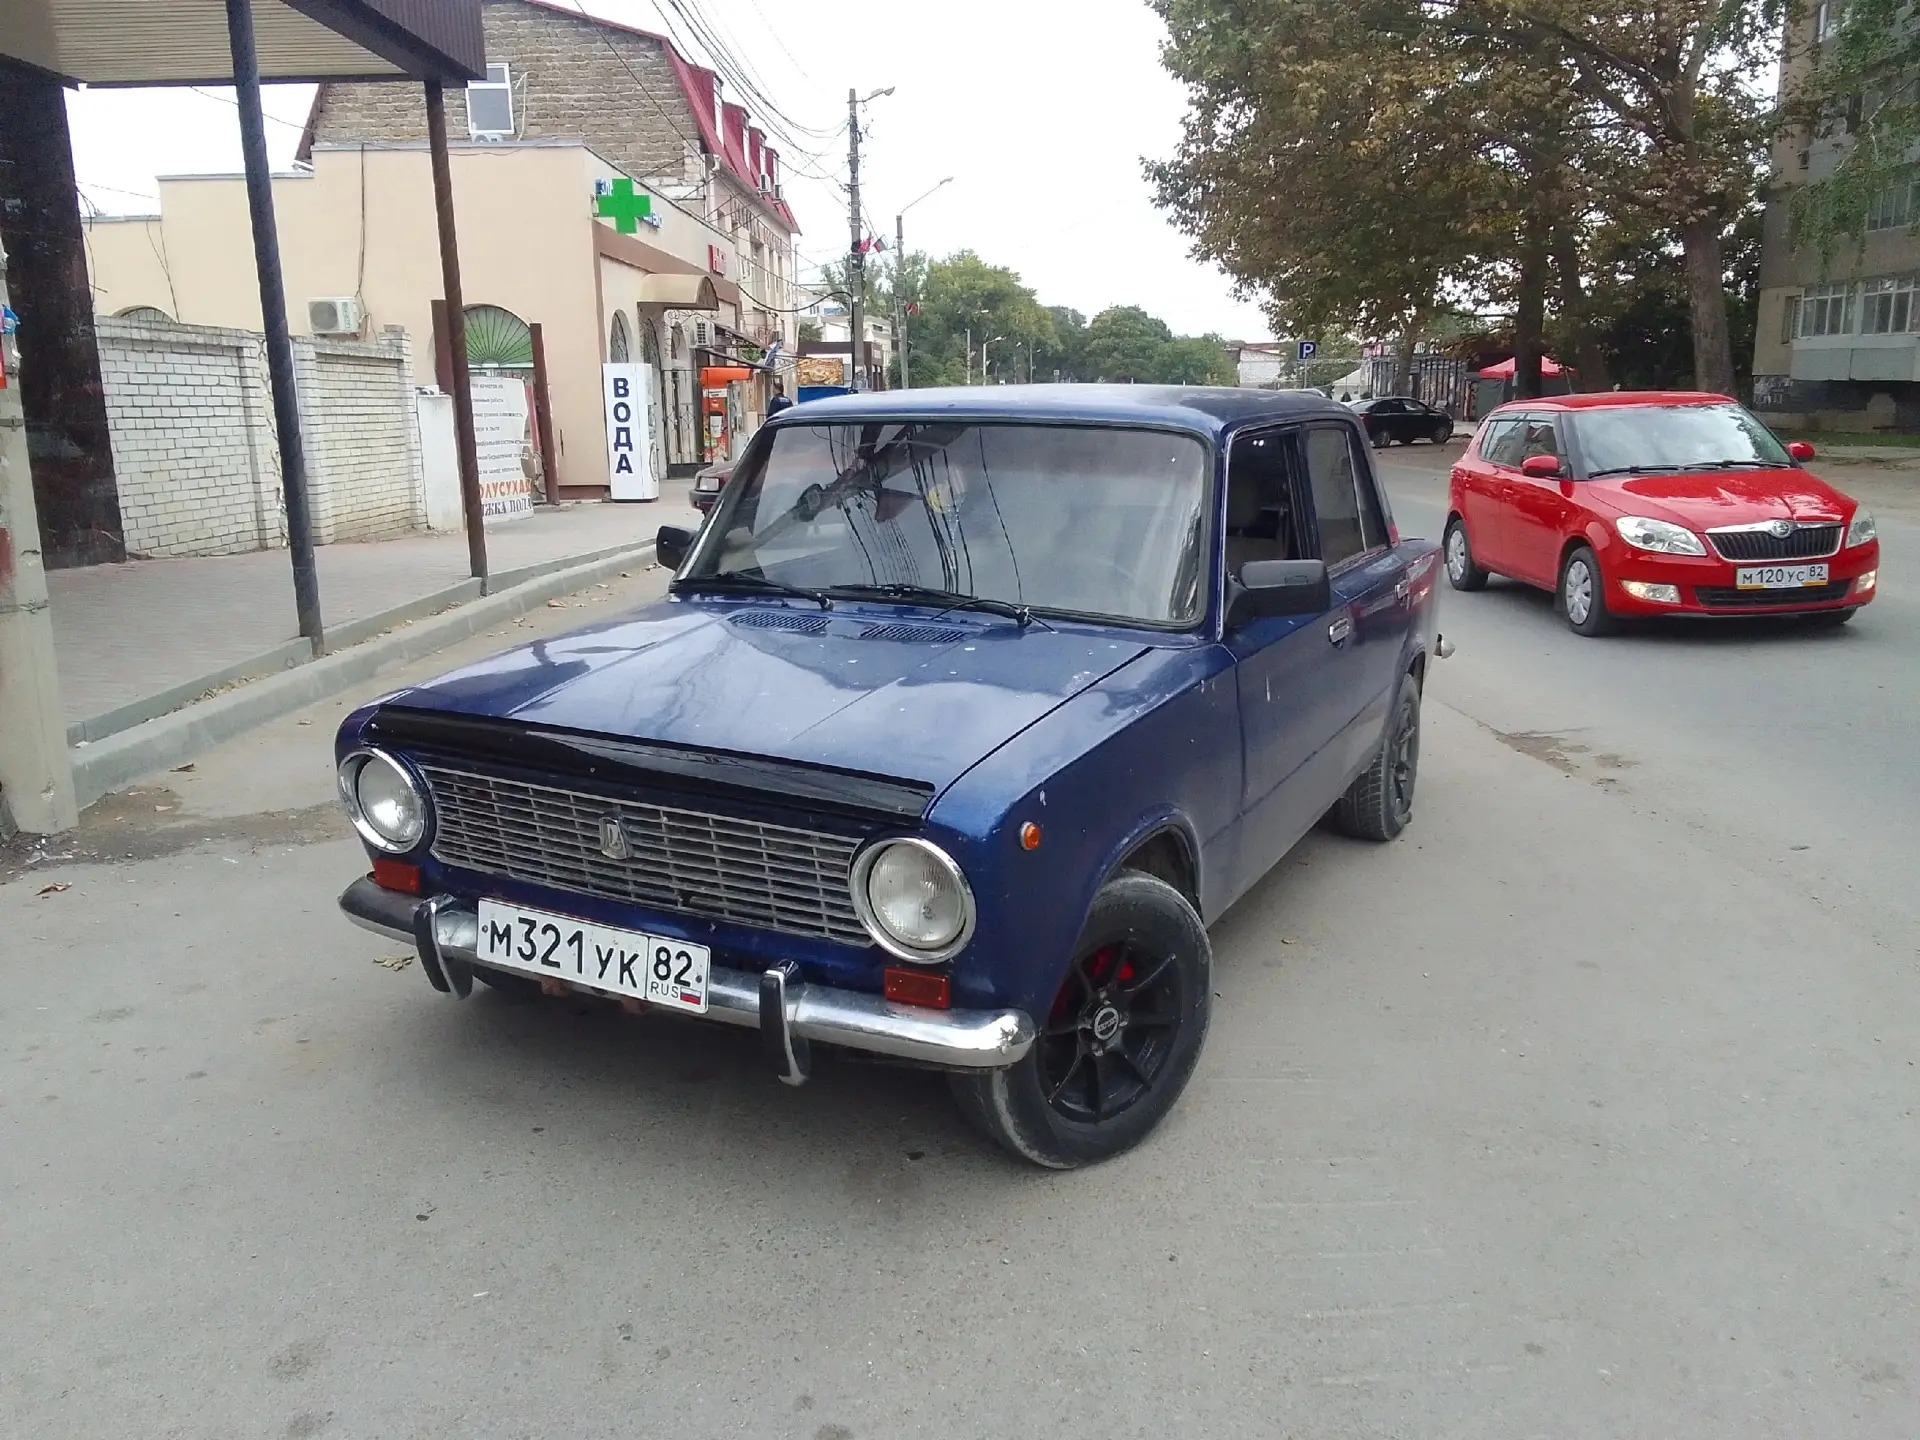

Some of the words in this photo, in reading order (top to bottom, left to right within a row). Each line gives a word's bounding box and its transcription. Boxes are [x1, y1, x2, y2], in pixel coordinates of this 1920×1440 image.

[1303, 342, 1314, 359] P
[613, 377, 634, 474] ВОДА
[1809, 565, 1825, 578] 82
[489, 916, 639, 989] М321УК
[653, 946, 693, 987] 82
[650, 981, 680, 999] RUS
